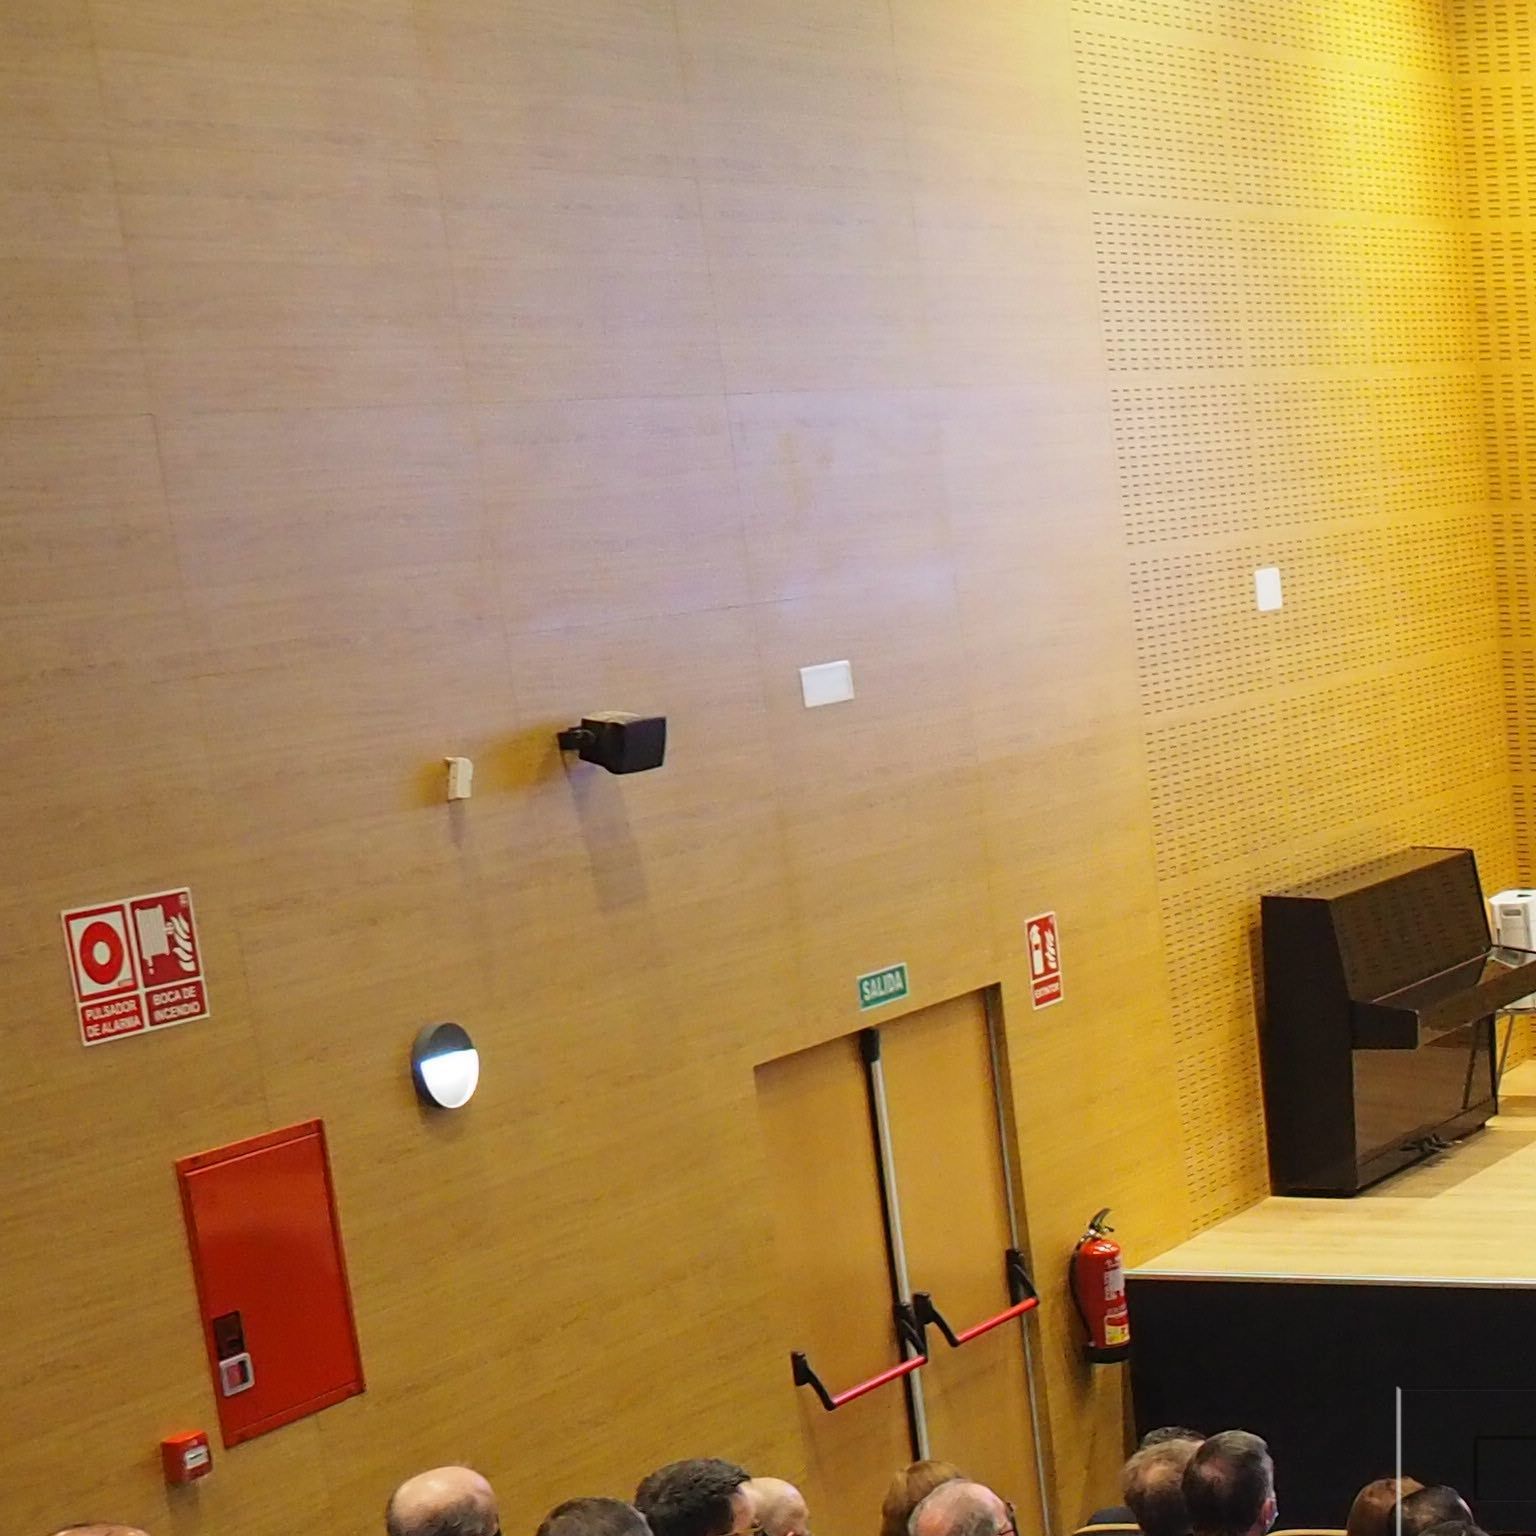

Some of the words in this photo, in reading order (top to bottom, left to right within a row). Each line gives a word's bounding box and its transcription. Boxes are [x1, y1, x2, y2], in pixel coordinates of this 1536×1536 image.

[152, 989, 182, 1006] BOCA
[181, 985, 197, 999] DE
[862, 970, 903, 1002] SALIDA
[85, 999, 138, 1021] PULSADOR
[153, 1000, 201, 1023] INCENDIO
[86, 1023, 102, 1039] DE
[101, 1015, 142, 1035] ALARMA
